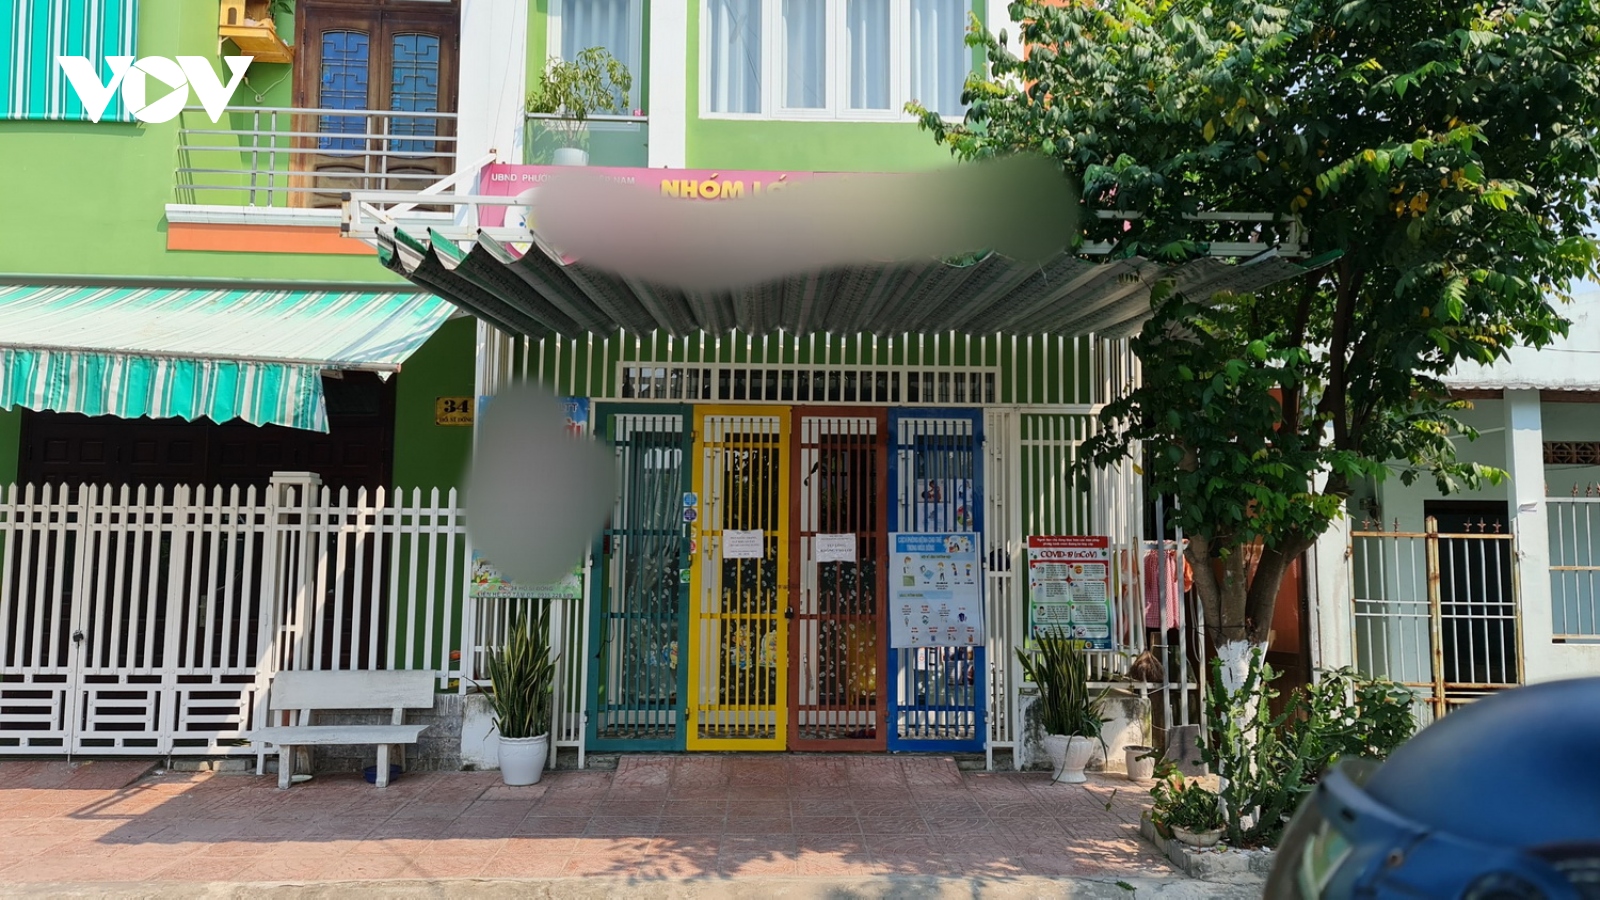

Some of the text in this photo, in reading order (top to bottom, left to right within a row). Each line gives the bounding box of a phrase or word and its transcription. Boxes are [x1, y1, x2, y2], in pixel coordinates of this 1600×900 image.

[491, 173, 518, 182] UBND
[660, 172, 745, 199] NHÓM
[443, 399, 470, 413] 34
